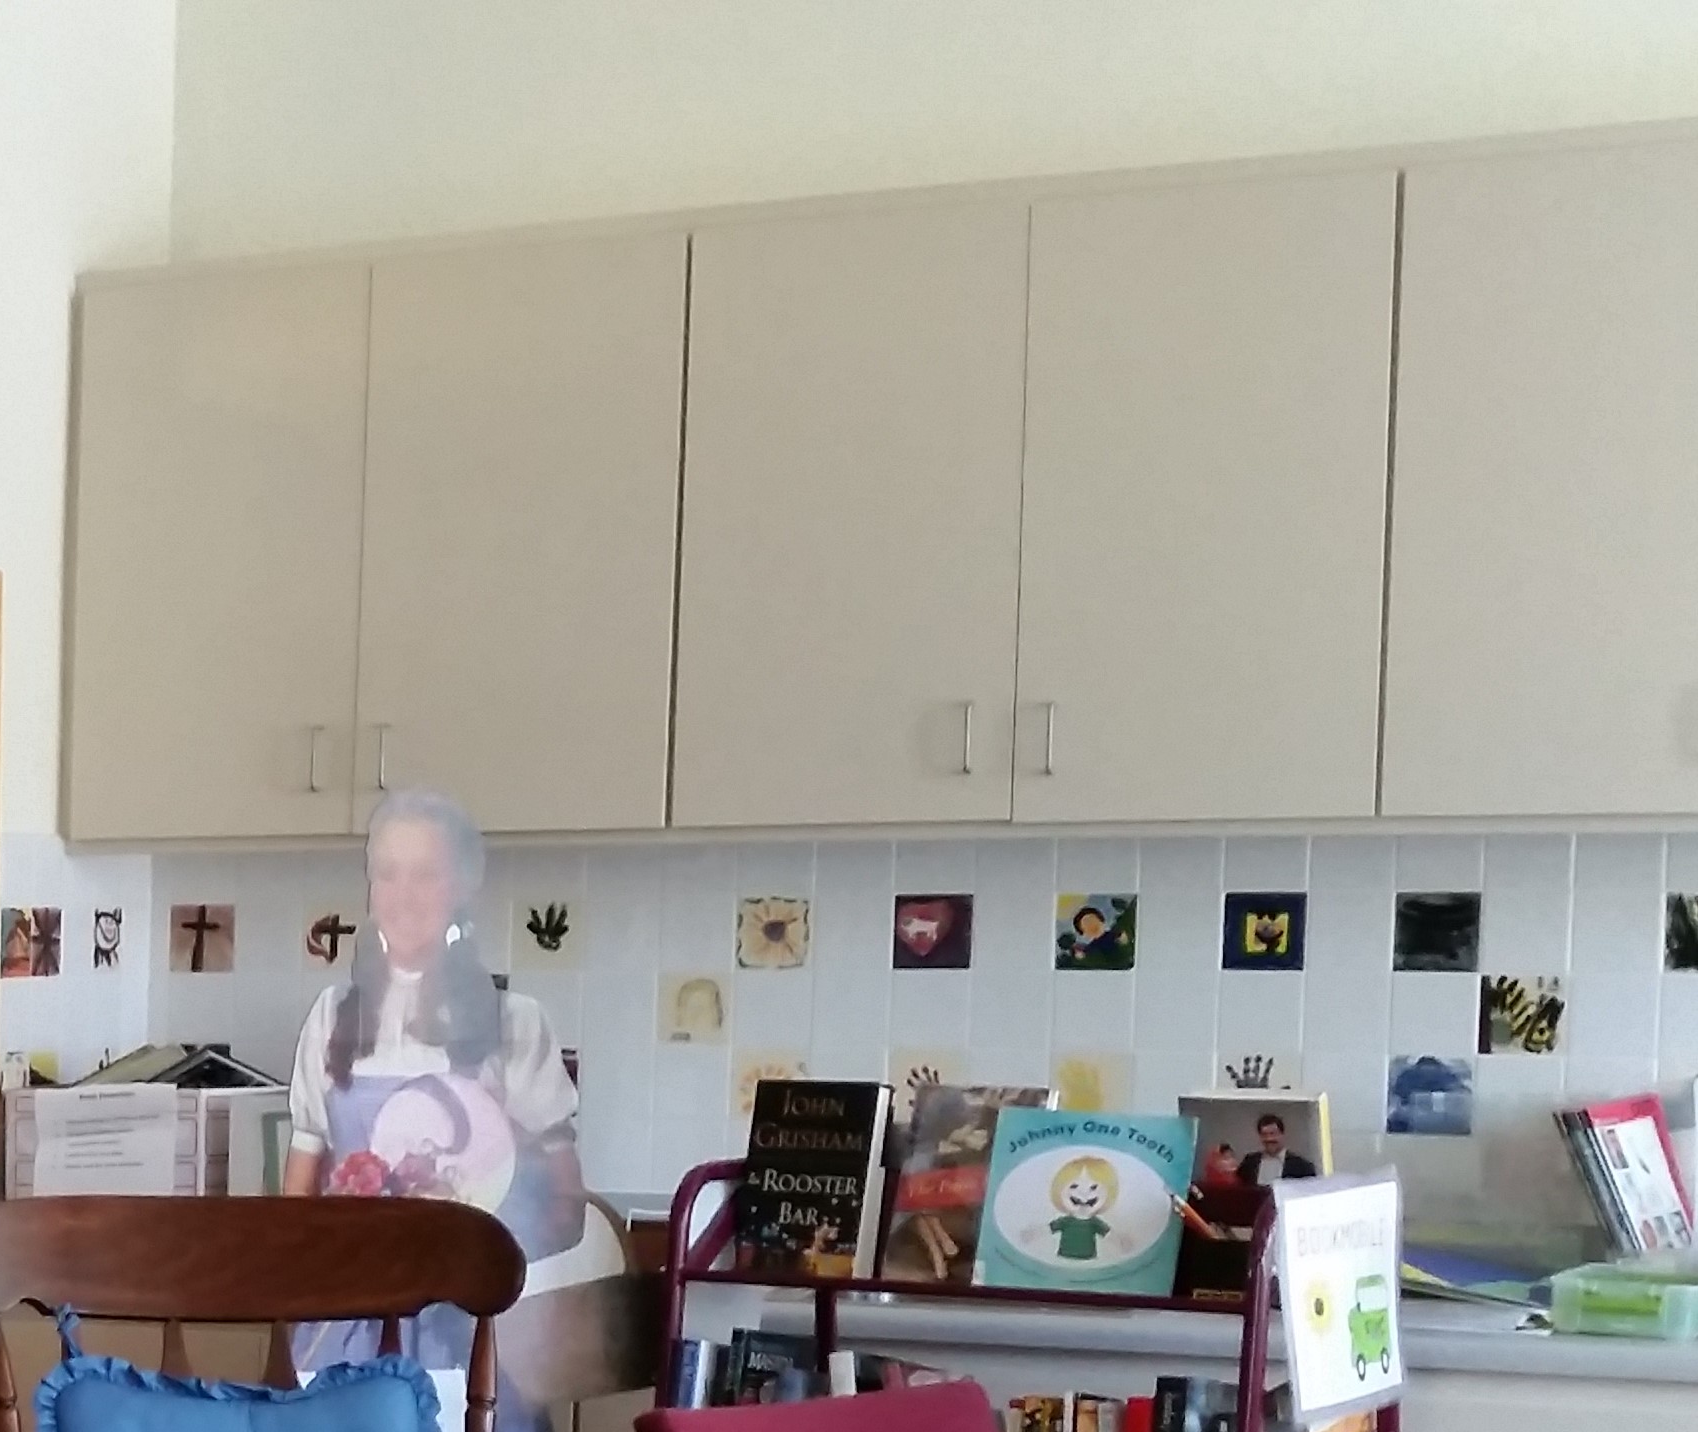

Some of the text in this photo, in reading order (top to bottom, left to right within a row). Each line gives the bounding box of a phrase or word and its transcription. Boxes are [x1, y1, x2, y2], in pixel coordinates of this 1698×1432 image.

[782, 1089, 846, 1117] JOHN
[754, 1123, 863, 1152] GRISHAM
[1007, 1120, 1175, 1164] Johnny One Tooth
[762, 1168, 857, 1195] ROOSTER
[778, 1202, 818, 1226] BAR
[1295, 1217, 1385, 1258] BOOKMOBILE
